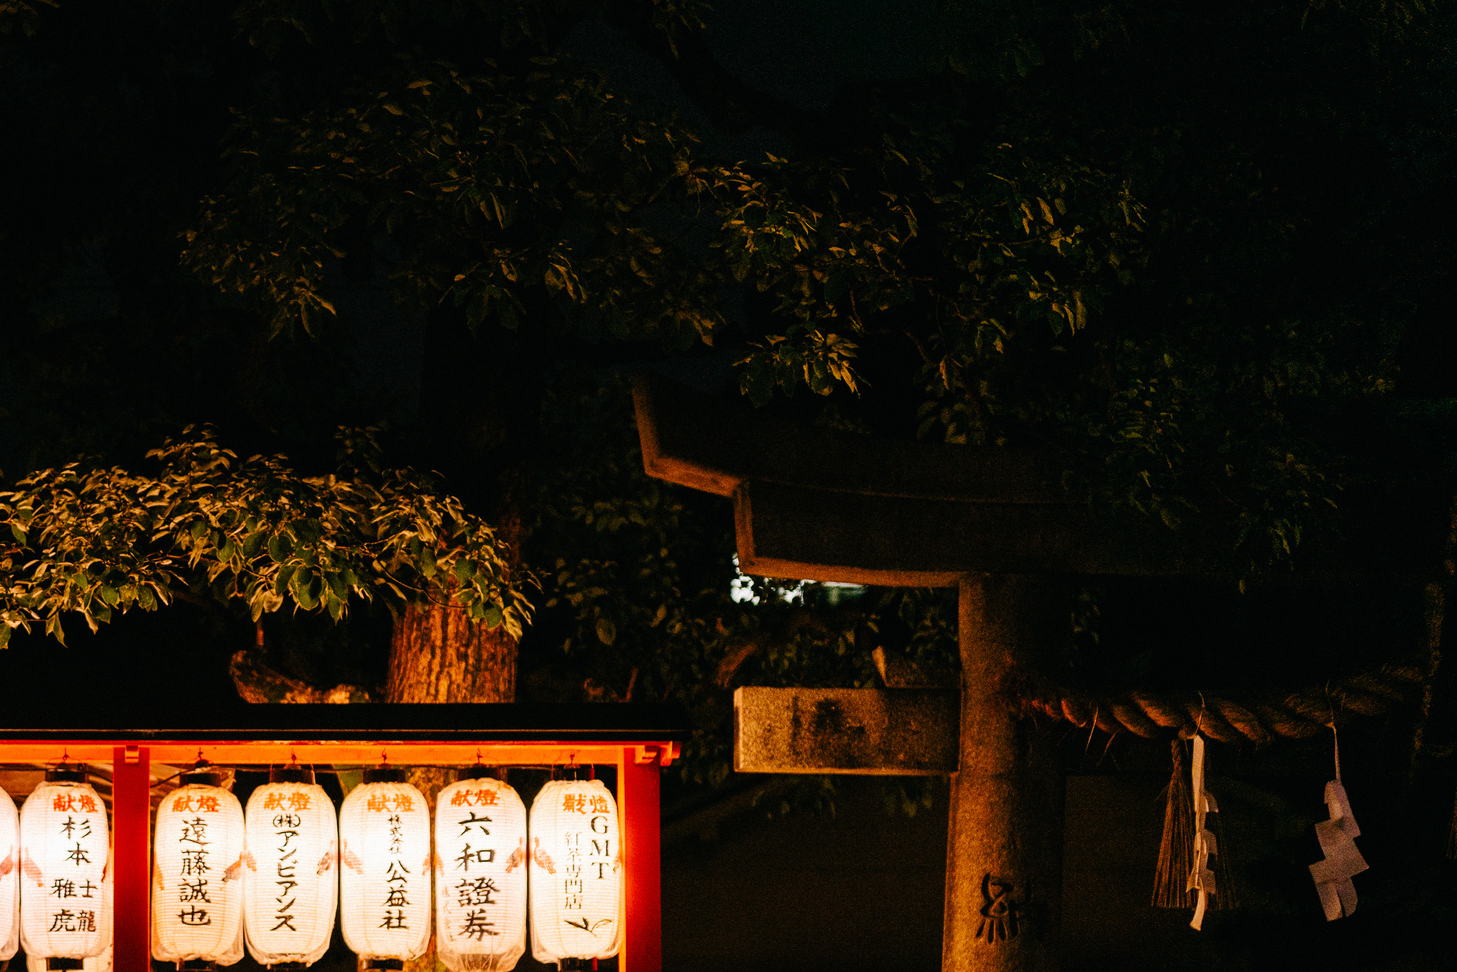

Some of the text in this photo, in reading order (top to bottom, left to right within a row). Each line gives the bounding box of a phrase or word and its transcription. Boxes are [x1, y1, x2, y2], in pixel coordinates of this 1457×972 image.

[53, 793, 99, 813] 献燈
[172, 794, 222, 813] 献燈
[263, 792, 312, 811] 献燈
[367, 794, 415, 813] 献燈
[451, 789, 501, 807] 献燈
[589, 815, 611, 880] GMT
[176, 816, 213, 926] 遠藤誠也
